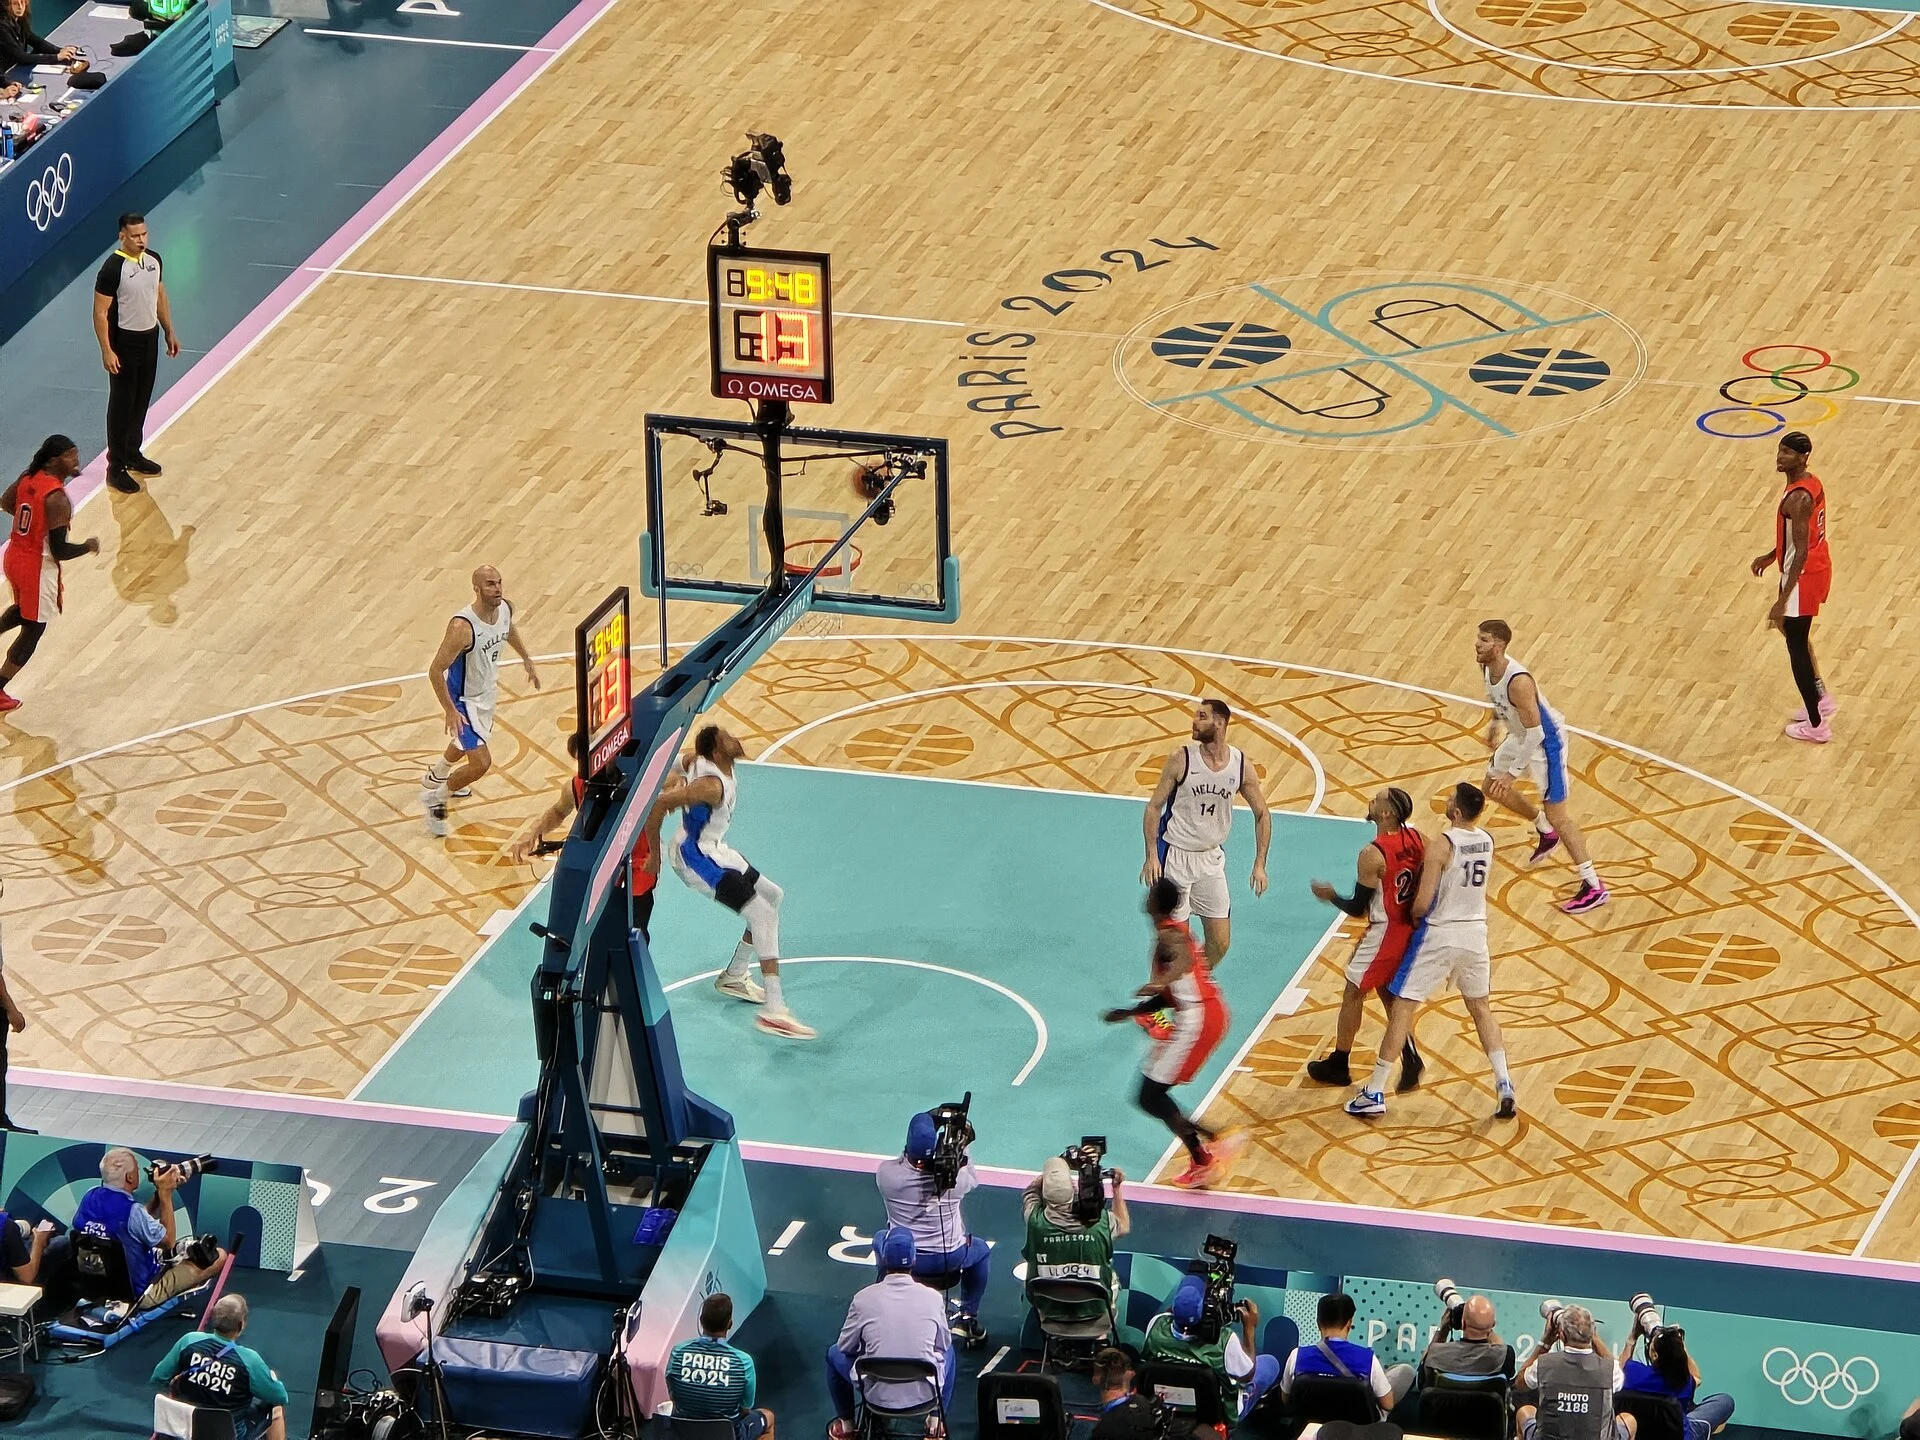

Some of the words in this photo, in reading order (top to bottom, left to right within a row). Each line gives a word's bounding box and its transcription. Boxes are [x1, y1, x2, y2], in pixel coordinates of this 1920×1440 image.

[1001, 236, 1220, 316] 2024
[749, 381, 817, 400] OMEGA
[957, 331, 1064, 439] PARIS
[18, 503, 32, 535] 0
[601, 726, 628, 762] OMEGA
[1192, 783, 1231, 799] HELLAS
[1200, 803, 1215, 816] 14
[1460, 860, 1486, 888] 16
[190, 1352, 236, 1380] PARIS
[682, 1352, 730, 1371] PARIS
[188, 1371, 232, 1395] 2024
[681, 1367, 729, 1387] 2024
[1557, 1391, 1589, 1403] PHOTO
[1557, 1401, 1589, 1414] 2188
